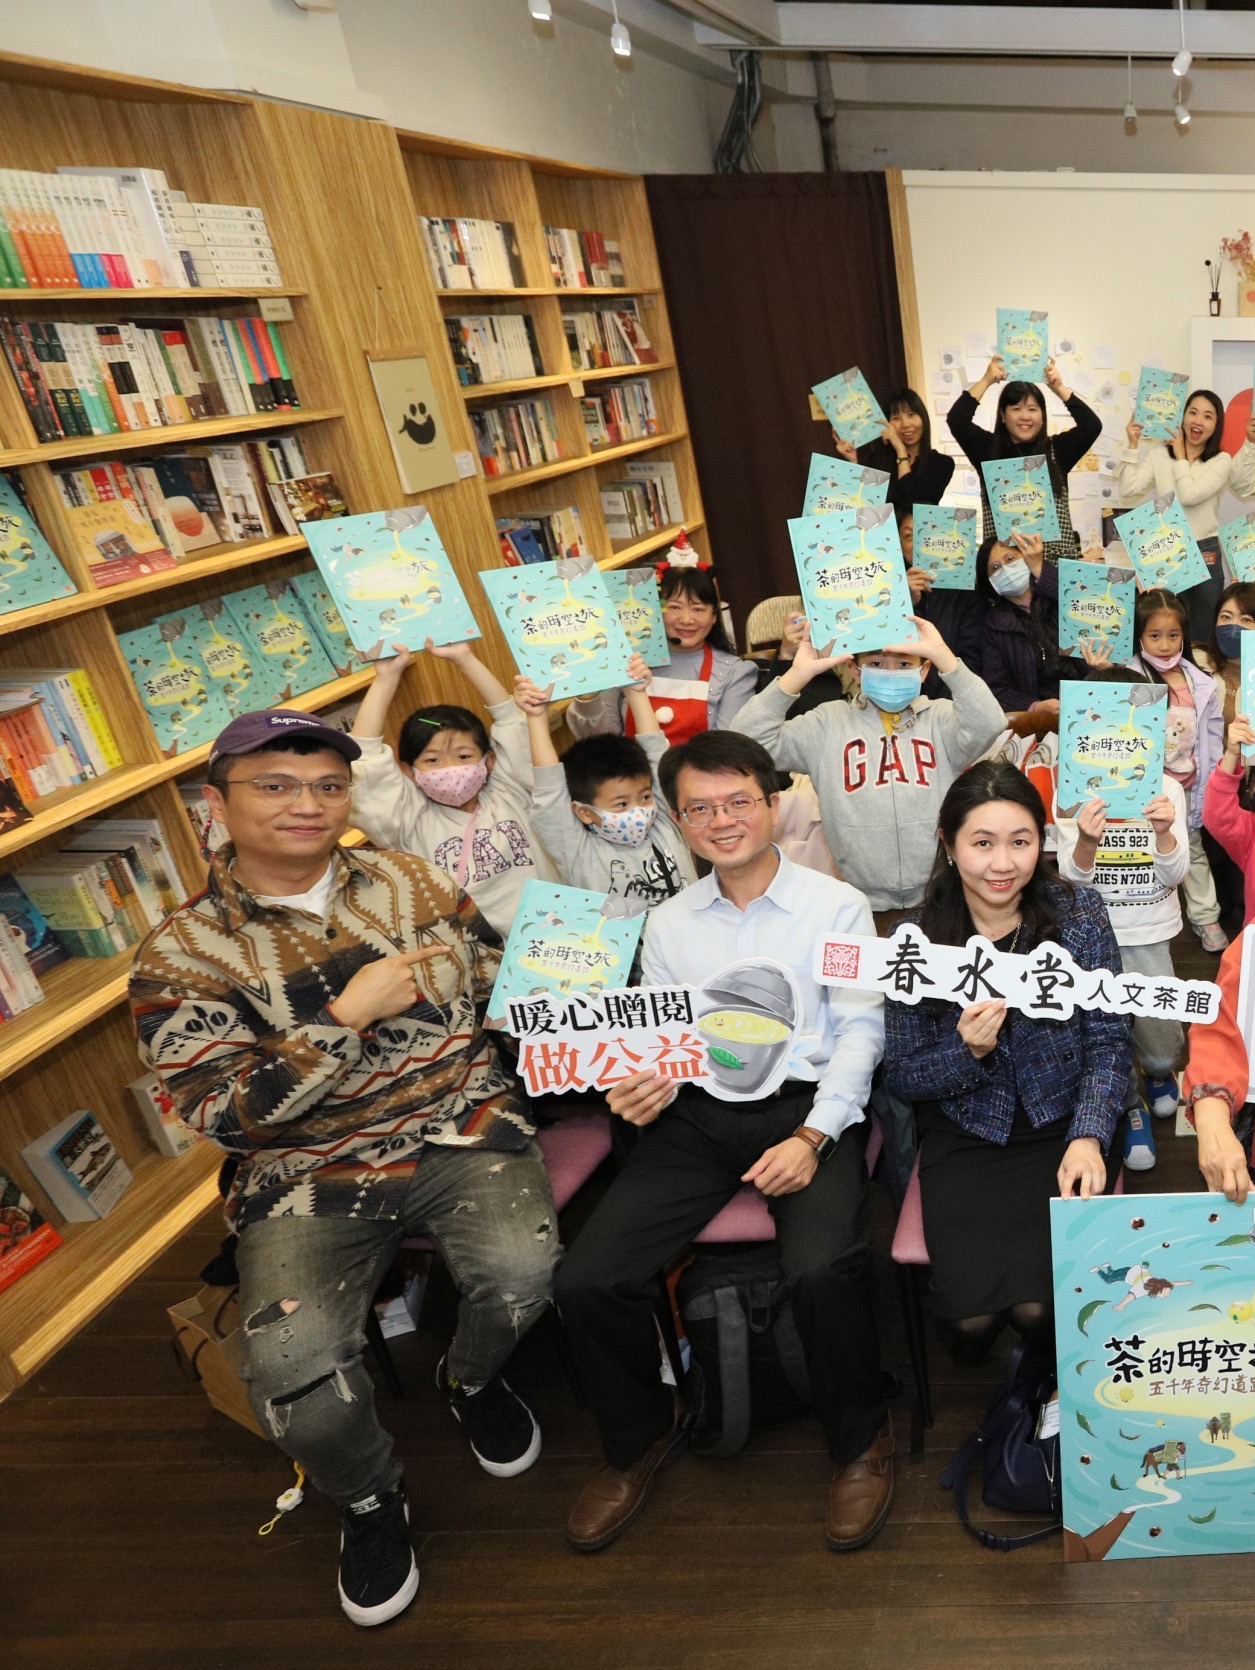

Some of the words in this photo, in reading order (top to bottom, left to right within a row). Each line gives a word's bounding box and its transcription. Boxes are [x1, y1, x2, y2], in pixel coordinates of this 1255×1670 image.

[816, 561, 888, 588] 茶的時空之旅
[520, 608, 599, 636] 茶的時空之旅
[1071, 600, 1121, 616] 茶的時空之旅
[1076, 735, 1147, 753] 茶的時空之旅
[842, 734, 938, 794] GAP
[435, 819, 534, 887] GAP
[1129, 836, 1149, 847] 923
[1120, 873, 1150, 885] N700
[527, 939, 612, 967] 茶的時空之旅
[878, 933, 1075, 1010] 春水堂
[1088, 979, 1212, 1015] 人文茶館
[509, 990, 694, 1036] 暖心贈閱
[522, 1033, 710, 1093] 做公益
